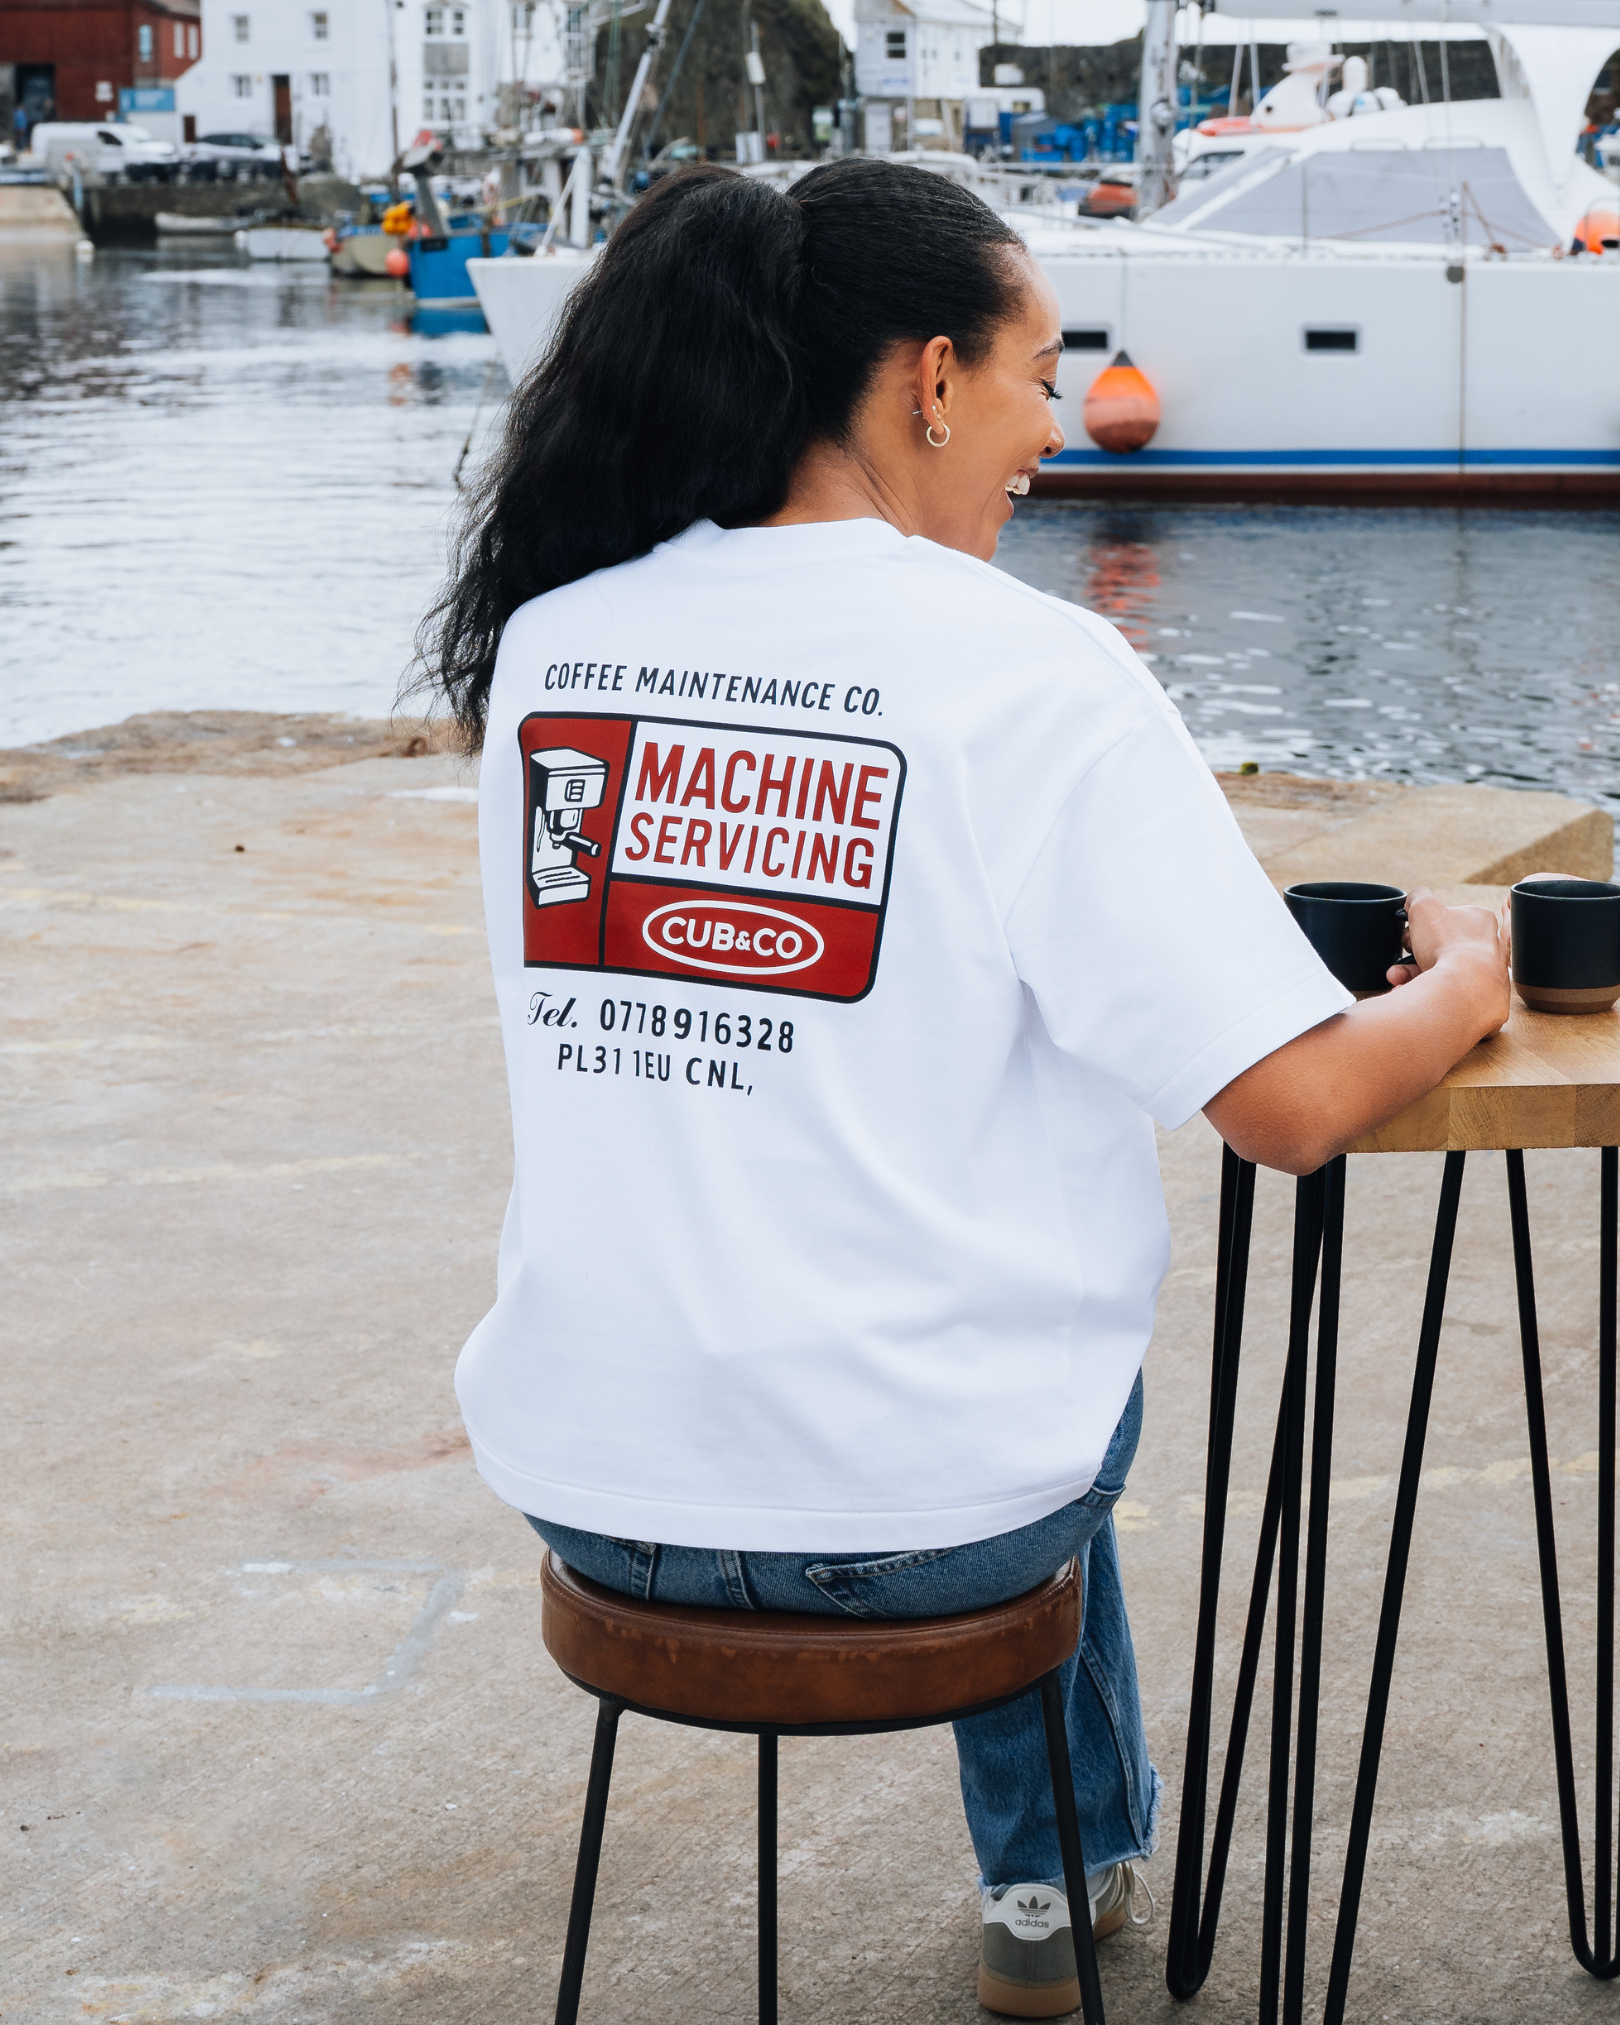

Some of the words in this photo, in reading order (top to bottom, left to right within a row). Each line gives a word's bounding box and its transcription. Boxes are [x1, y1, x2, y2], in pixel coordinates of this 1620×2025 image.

[544, 662, 628, 691] COFFEE
[635, 666, 836, 711] MAINTENANCE
[843, 685, 884, 717] CO.
[634, 741, 889, 831] MACHINE
[624, 811, 875, 890] SERVICING
[661, 916, 803, 960] CUB&CO
[527, 991, 578, 1028] Tel.
[599, 998, 794, 1054] 0778916328
[557, 1043, 621, 1075] PL31
[632, 1049, 671, 1082] 1EU
[685, 1057, 753, 1096] CNL,
[1014, 1917, 1050, 1929] adidas
